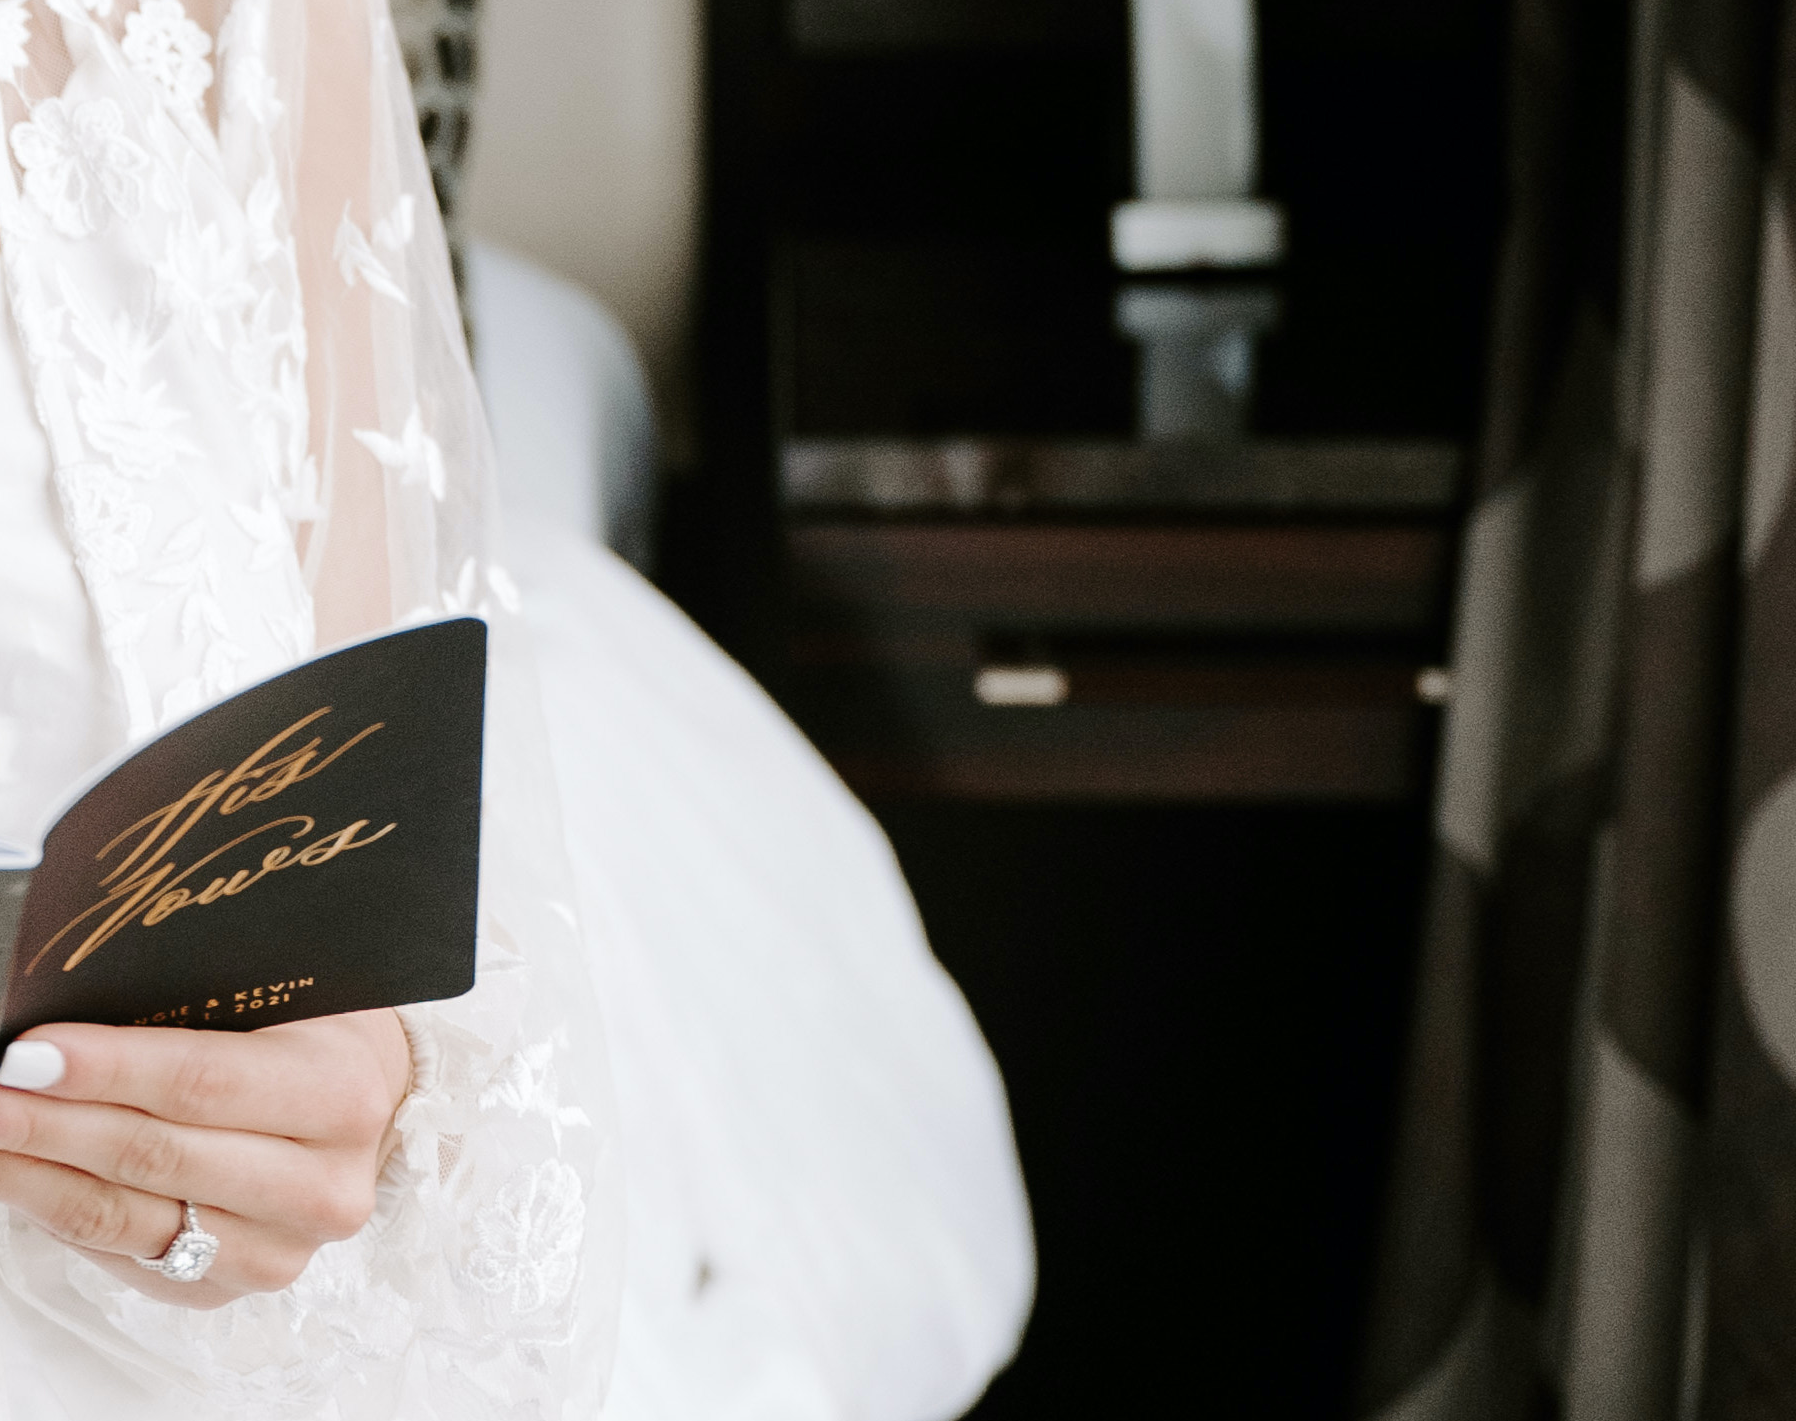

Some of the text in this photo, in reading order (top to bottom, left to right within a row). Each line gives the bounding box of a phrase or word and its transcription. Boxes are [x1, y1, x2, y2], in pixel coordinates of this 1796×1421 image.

[96, 705, 385, 895] His
[134, 1005, 190, 1026] NGIE
[205, 998, 220, 1009] &
[234, 977, 315, 1001] KEVIN
[234, 993, 290, 1013] 2021
